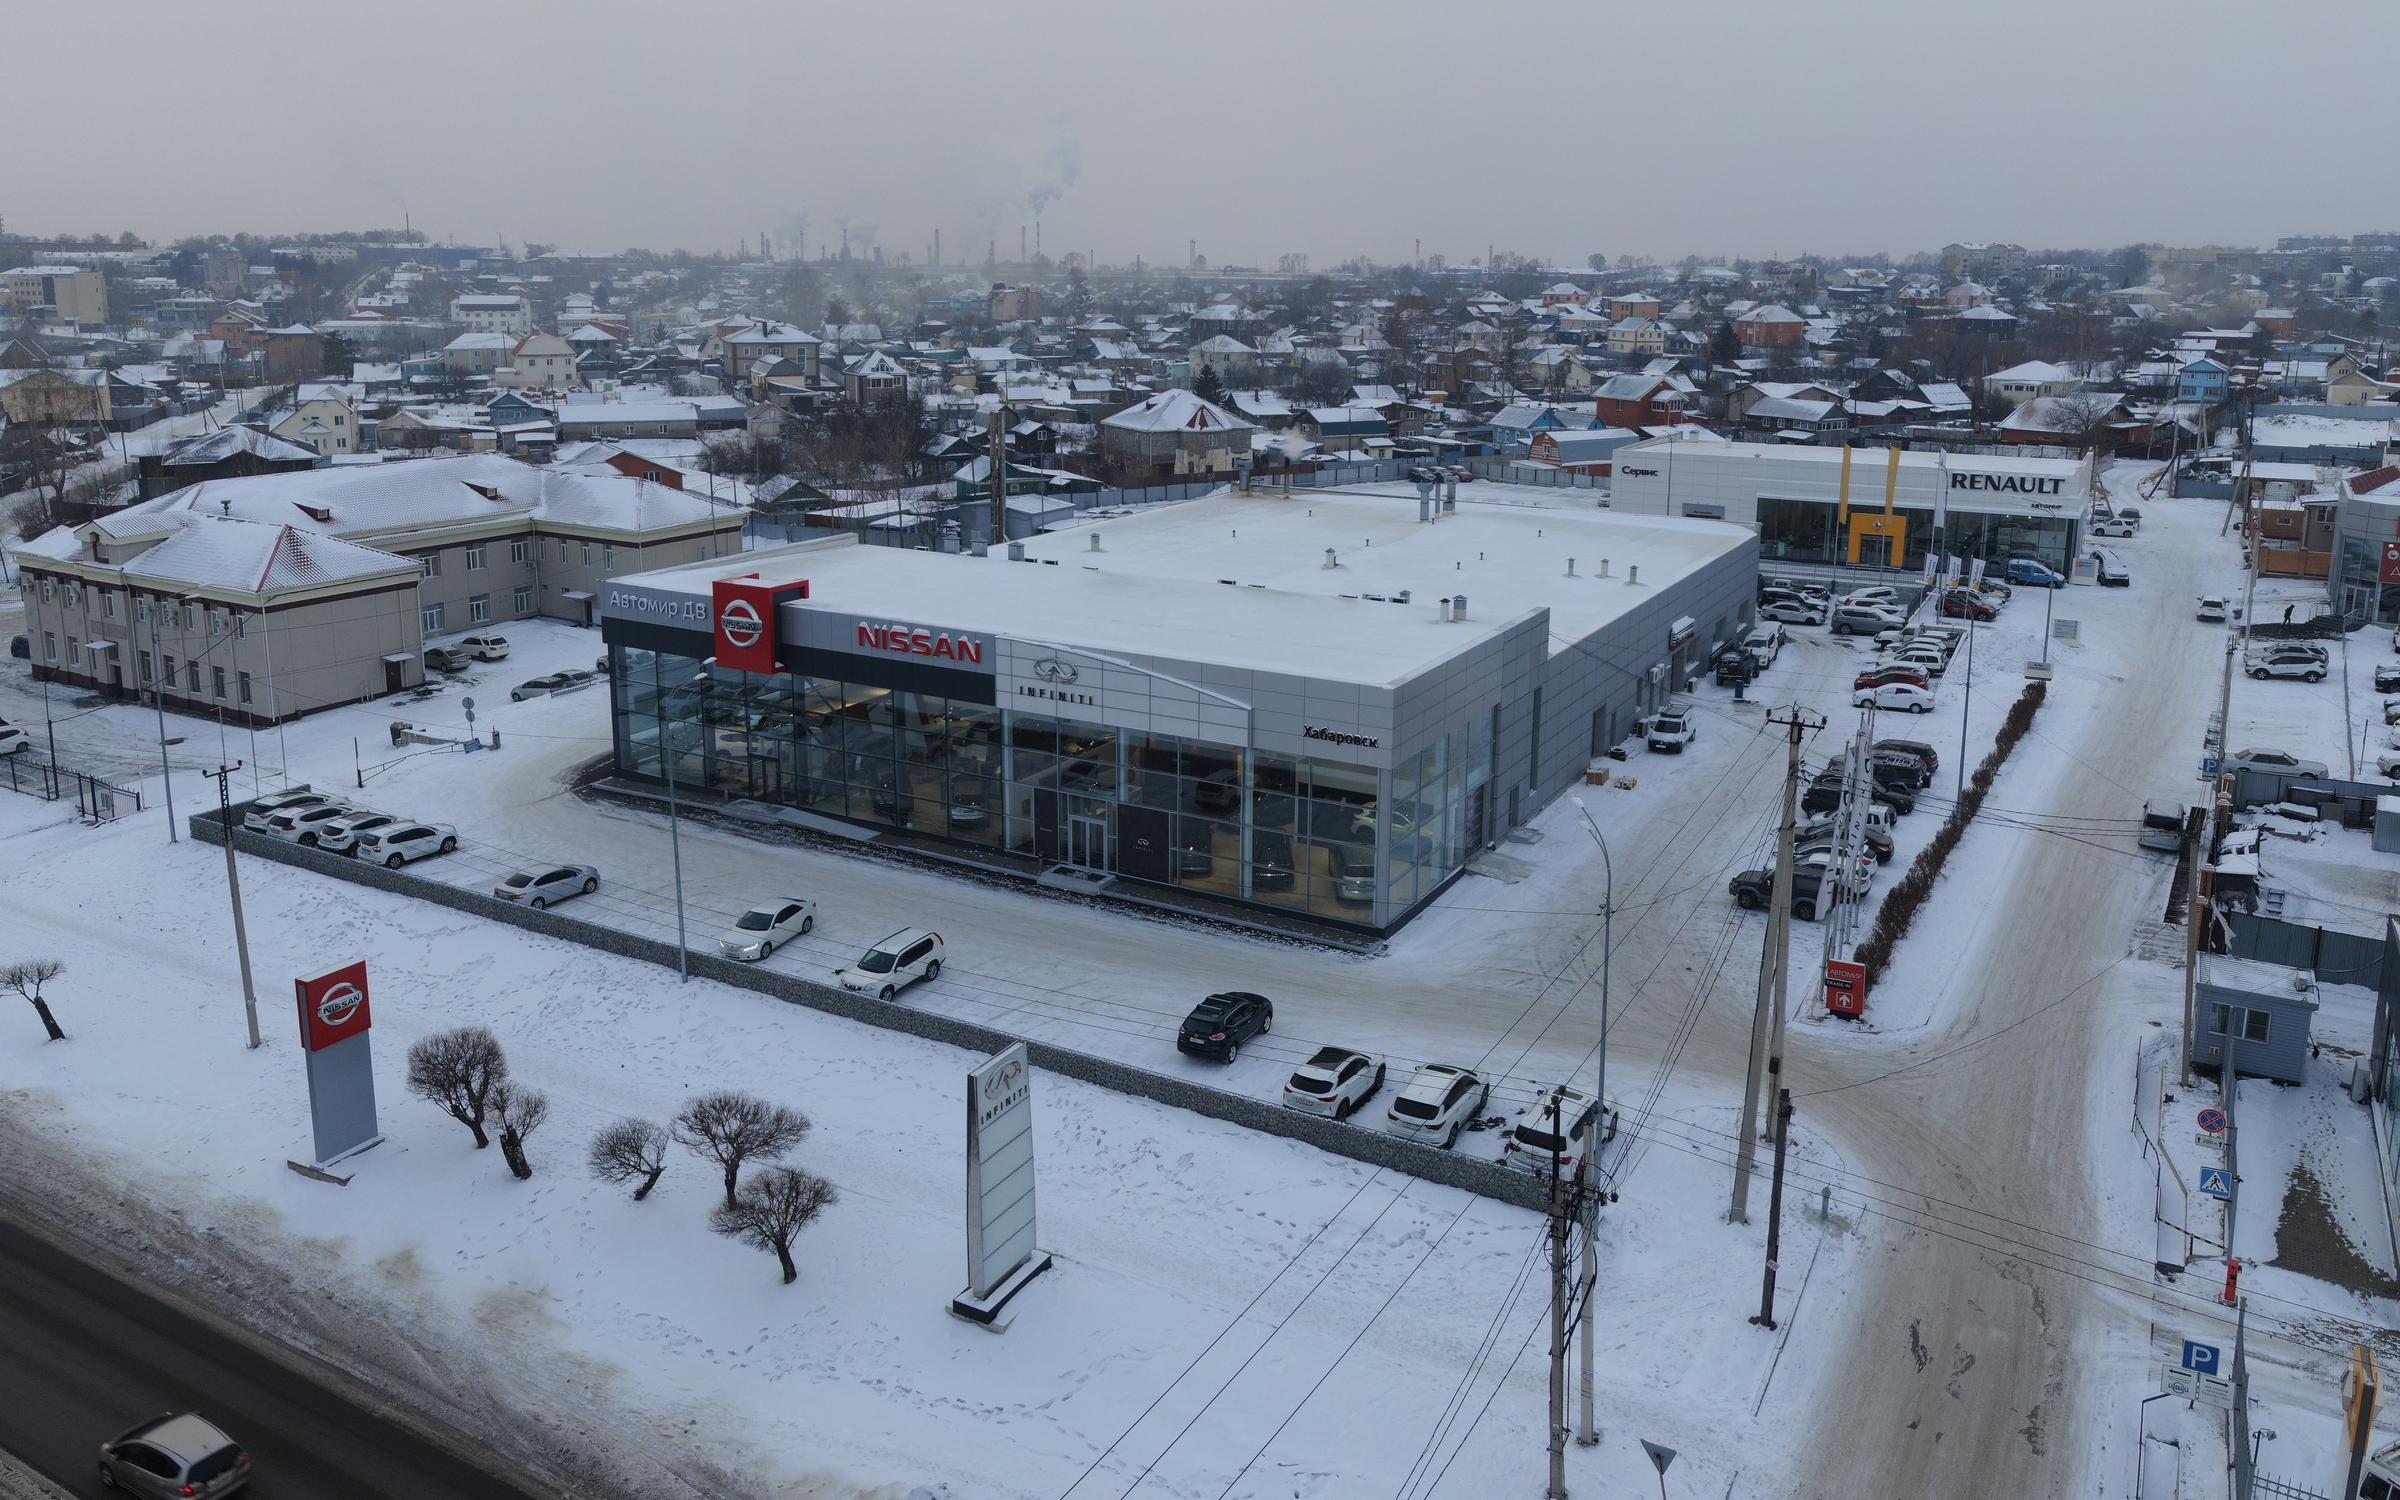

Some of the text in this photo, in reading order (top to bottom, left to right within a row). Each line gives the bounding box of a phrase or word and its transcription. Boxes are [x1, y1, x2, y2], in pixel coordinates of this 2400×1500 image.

[1622, 465, 1659, 478] Сервис
[1951, 472, 2066, 494] RENAULT
[610, 591, 707, 620] Автомир ДВ
[722, 619, 756, 631] NISSAN
[858, 622, 983, 664] NISSAN
[1019, 685, 1093, 705] INFINITI
[1303, 724, 1379, 748] Хабаровск
[2207, 760, 2216, 771] P
[323, 994, 360, 1014] NISSAN
[981, 1084, 1028, 1125] INFINITI
[2191, 1345, 2212, 1368] P
